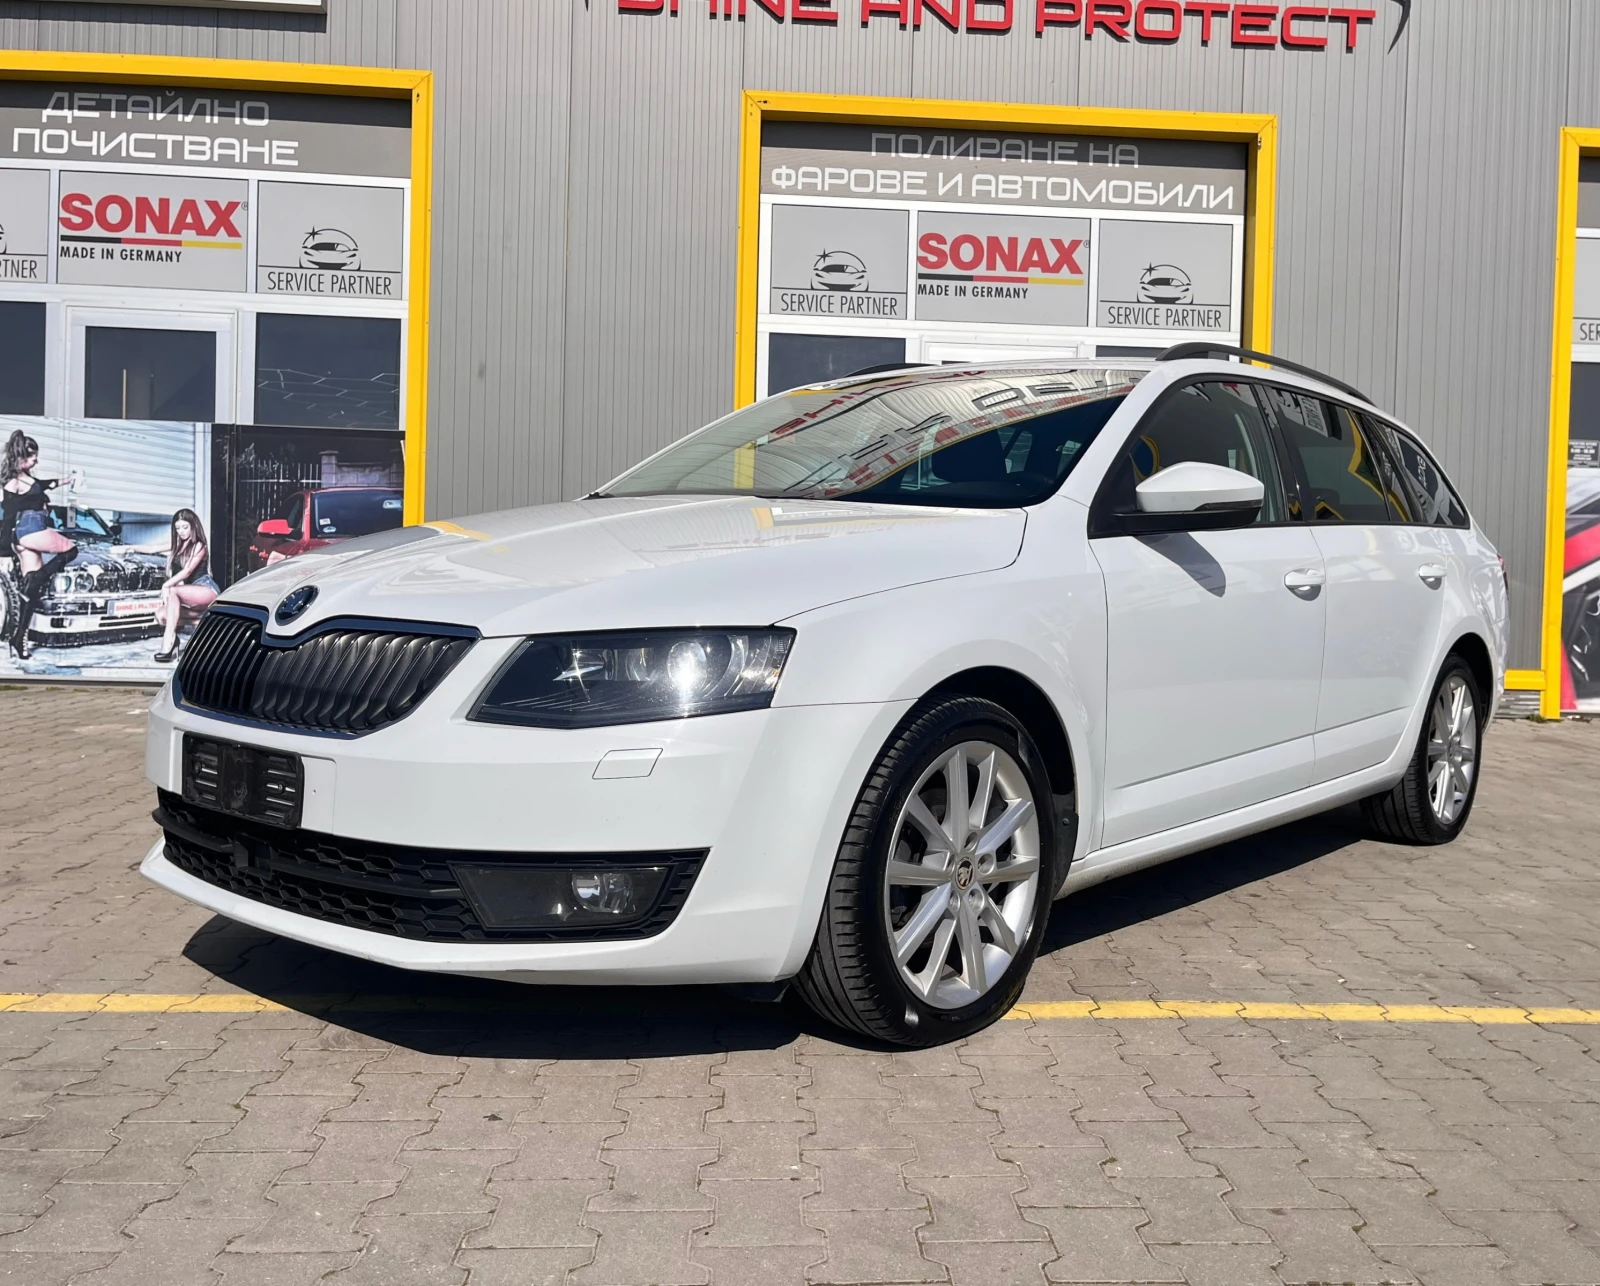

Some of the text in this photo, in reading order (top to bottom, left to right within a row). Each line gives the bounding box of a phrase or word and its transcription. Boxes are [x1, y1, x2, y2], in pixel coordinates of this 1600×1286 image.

[861, 0, 1013, 30] AND
[1035, 0, 1376, 48] PROTECT
[42, 90, 270, 127] ДЕТАЙЛНО
[12, 128, 299, 166] ПОЧИСТВАНЕ
[871, 132, 1140, 168] ПОЛИРАНЕ НА
[771, 165, 1233, 209] ФАРОВЕ И АВТОМОБИЛИ
[60, 246, 182, 264] MADE IN GERMANY
[0, 258, 38, 279] TNER
[267, 271, 392, 296] SERVICE PARTNER
[918, 283, 1029, 300] MADE IN GERMANY
[781, 293, 898, 316] SERVICE PARTNER
[1108, 306, 1222, 329] SERVICE PARTNER
